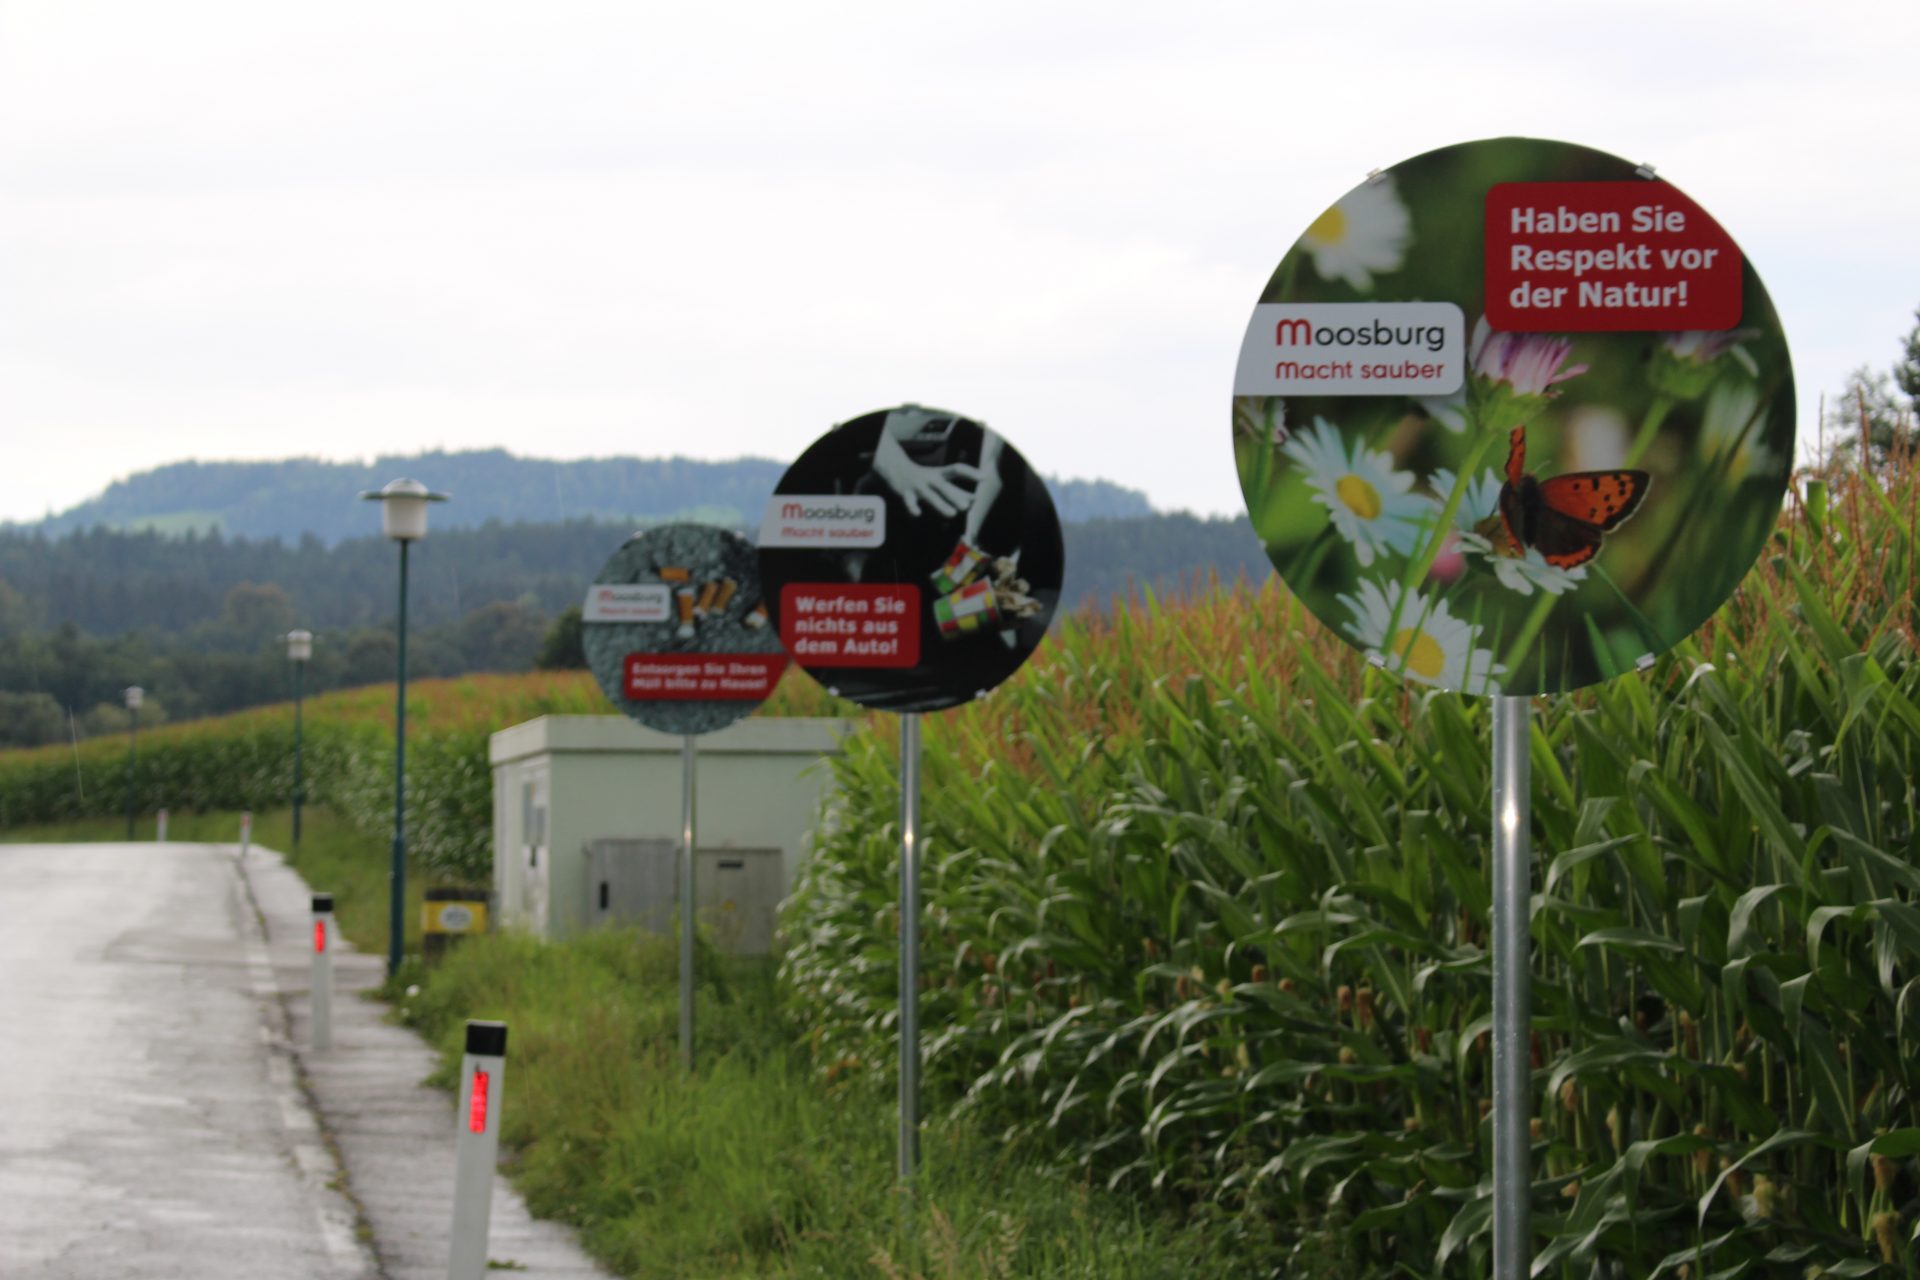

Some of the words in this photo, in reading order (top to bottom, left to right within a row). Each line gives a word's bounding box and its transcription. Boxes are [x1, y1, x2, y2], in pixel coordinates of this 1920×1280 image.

[1511, 207, 1620, 233] Haben
[1632, 206, 1685, 233] Sie
[1511, 244, 1651, 276] Respekt
[1661, 248, 1719, 270] vor
[1510, 282, 1567, 308] der
[1579, 282, 1688, 308] Natur!
[1361, 360, 1444, 380] sauber
[829, 527, 874, 538] sauber
[795, 597, 868, 613] Werfen
[874, 597, 905, 613] Sie
[795, 618, 857, 633] nichts
[863, 621, 898, 633] aus
[795, 639, 837, 654] dem
[843, 639, 898, 655] Auto!
